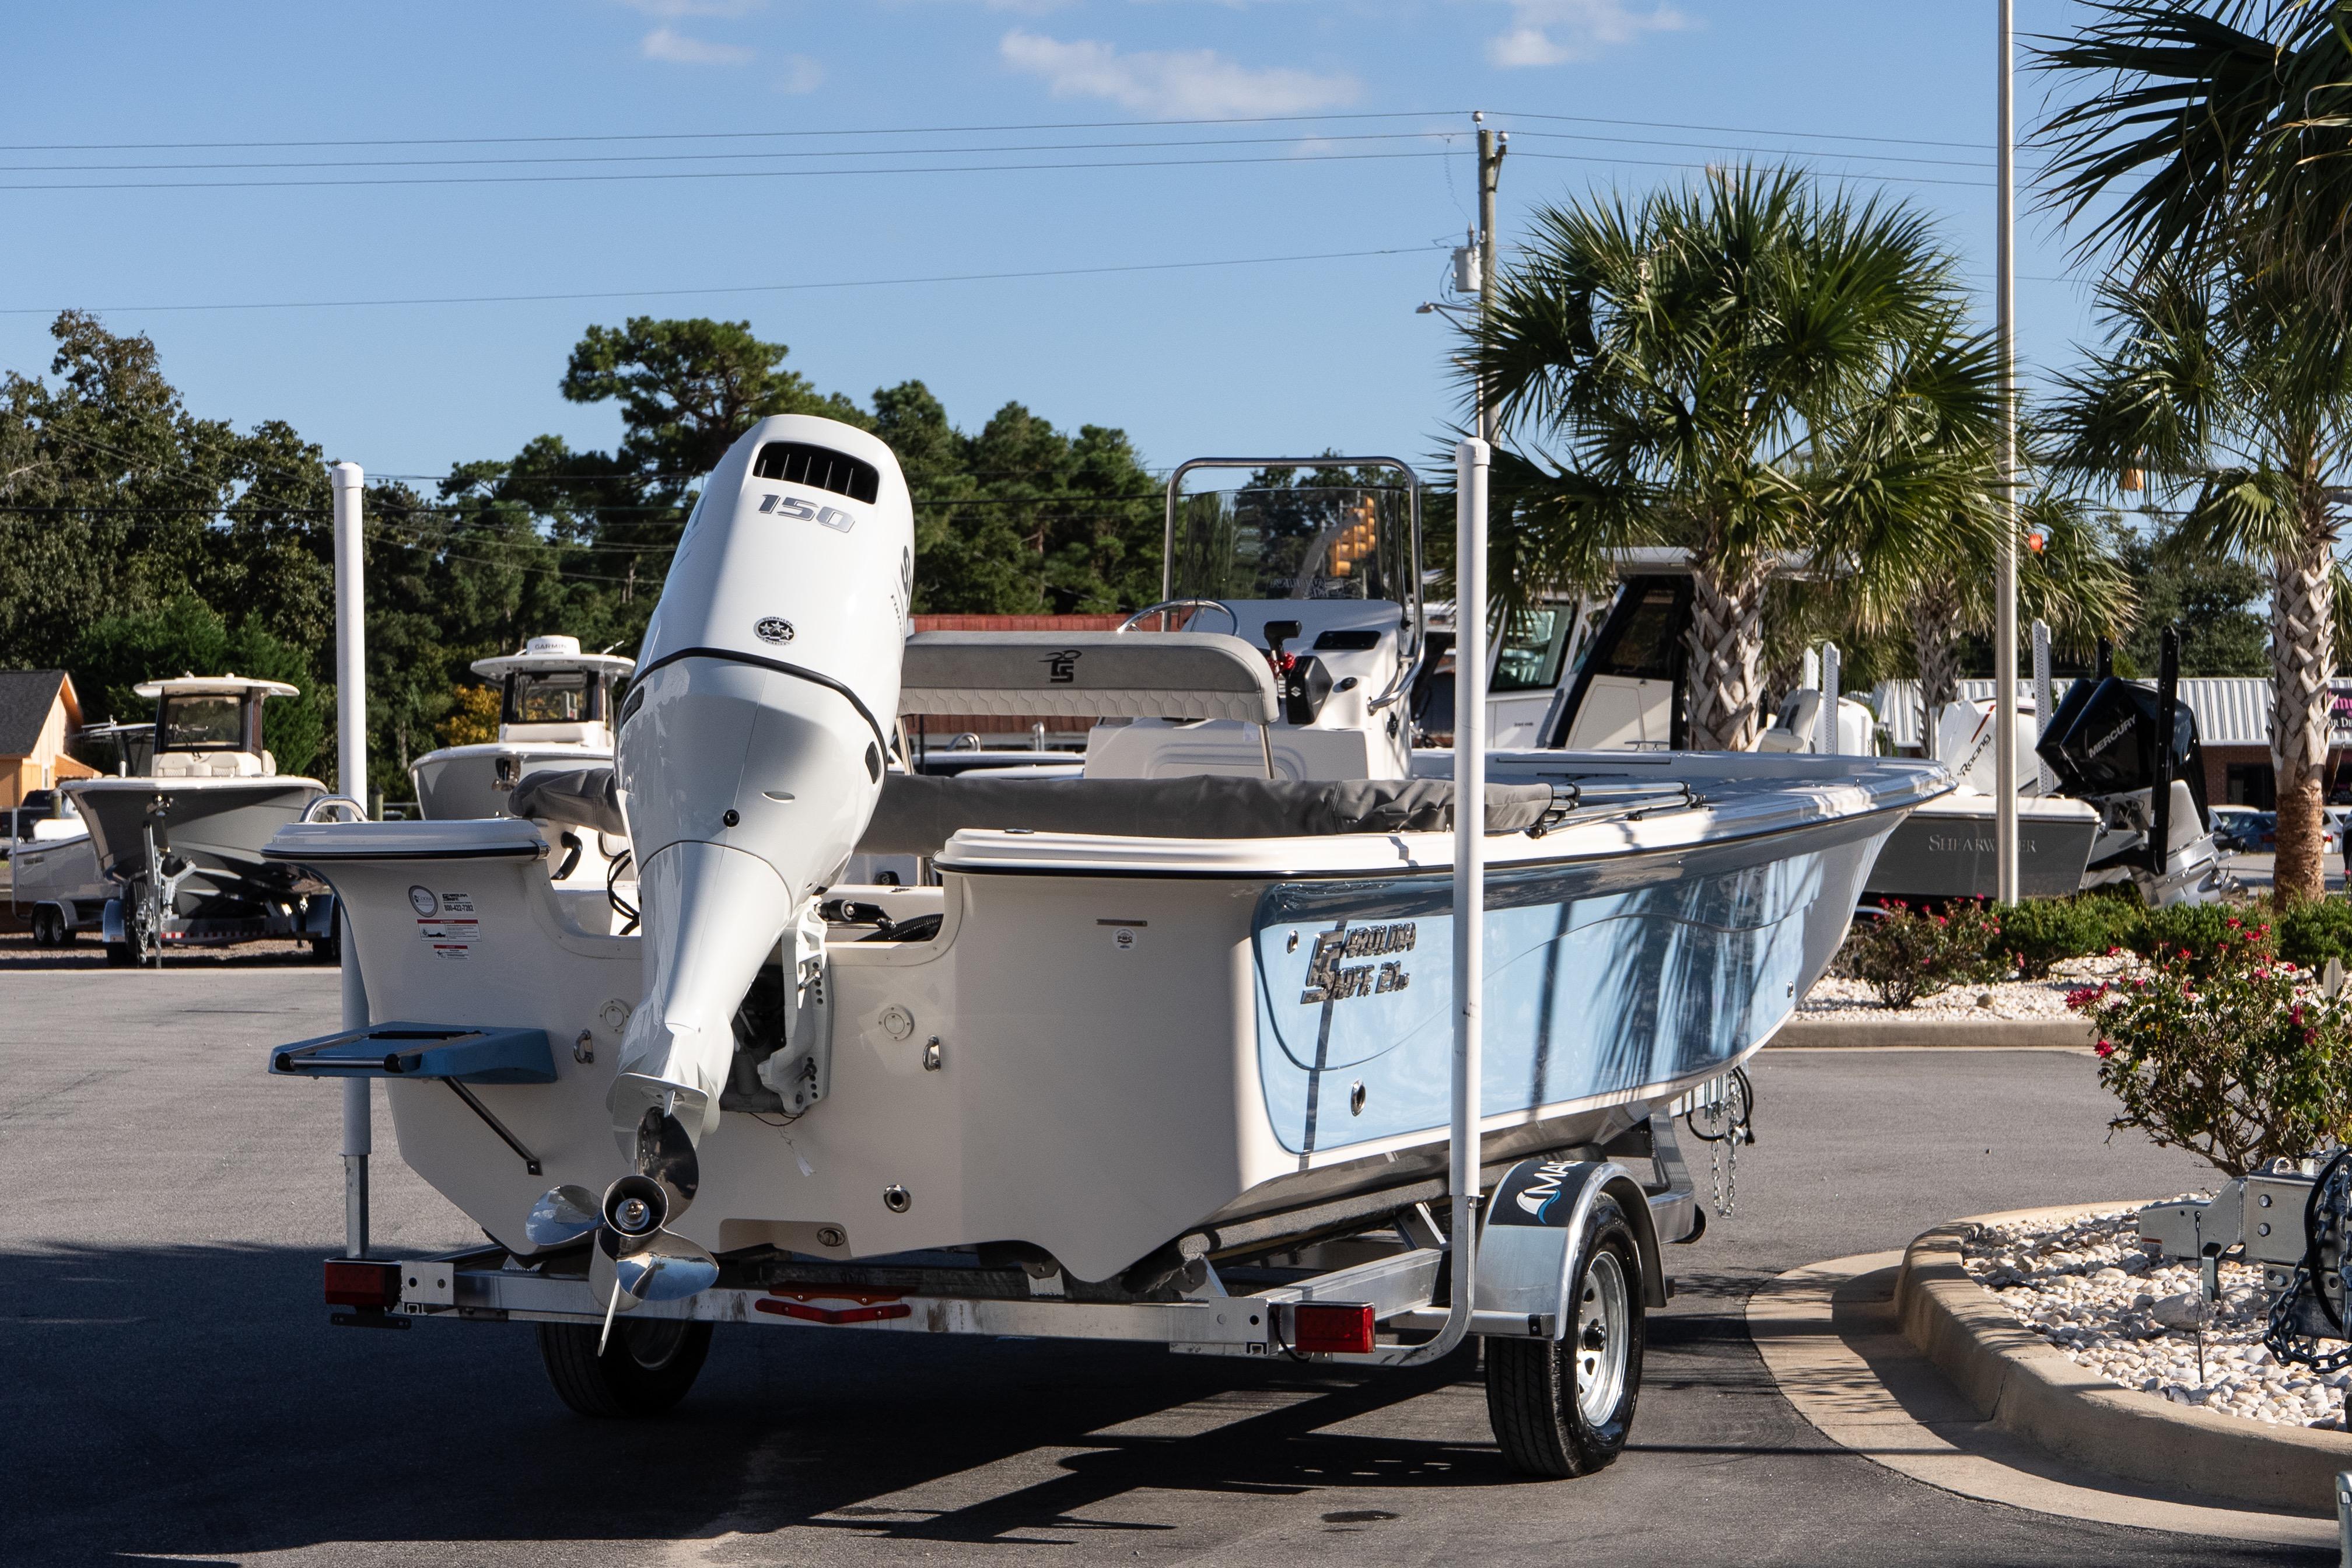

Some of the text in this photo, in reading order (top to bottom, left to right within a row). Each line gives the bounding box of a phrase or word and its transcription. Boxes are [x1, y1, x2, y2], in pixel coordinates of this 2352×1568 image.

[758, 495, 855, 533] 150
[1958, 733, 1991, 776] Racing
[2088, 714, 2136, 758] MERCURY
[1929, 834, 2036, 853] SHEARWER
[1306, 922, 1416, 986] CAROLINA
